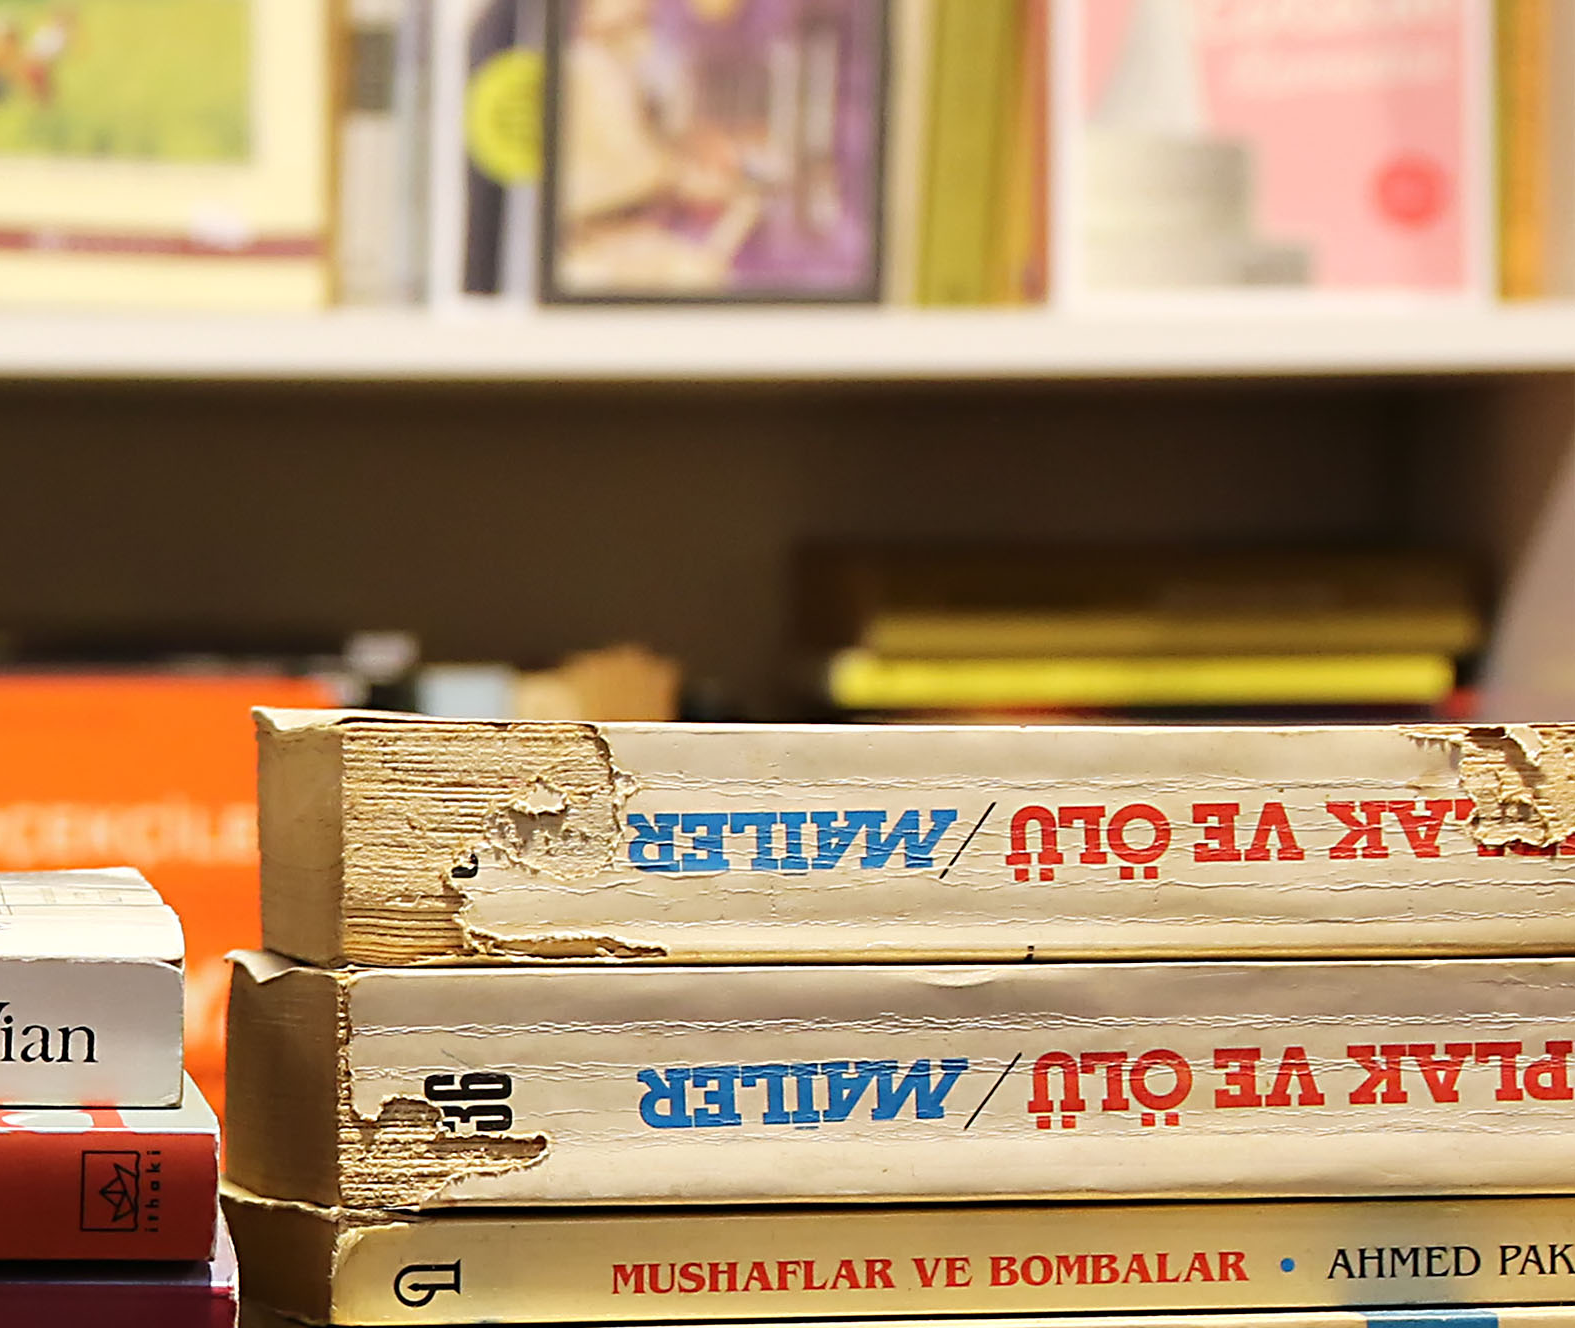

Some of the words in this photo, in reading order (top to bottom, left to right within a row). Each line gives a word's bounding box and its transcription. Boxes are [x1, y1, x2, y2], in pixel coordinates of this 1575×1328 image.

[1005, 802, 1172, 882] ÖLÜ
[1192, 801, 1305, 863] VE
[1028, 1049, 1192, 1129] ÖLÜ
[1213, 1045, 1325, 1109] VE
[611, 1258, 894, 1296] MUSHAFLAR
[913, 1256, 973, 1290] VE
[989, 1250, 1249, 1288] BOMBALAR
[1326, 1244, 1481, 1281] AHMED
[1498, 1242, 1575, 1277] PAK
